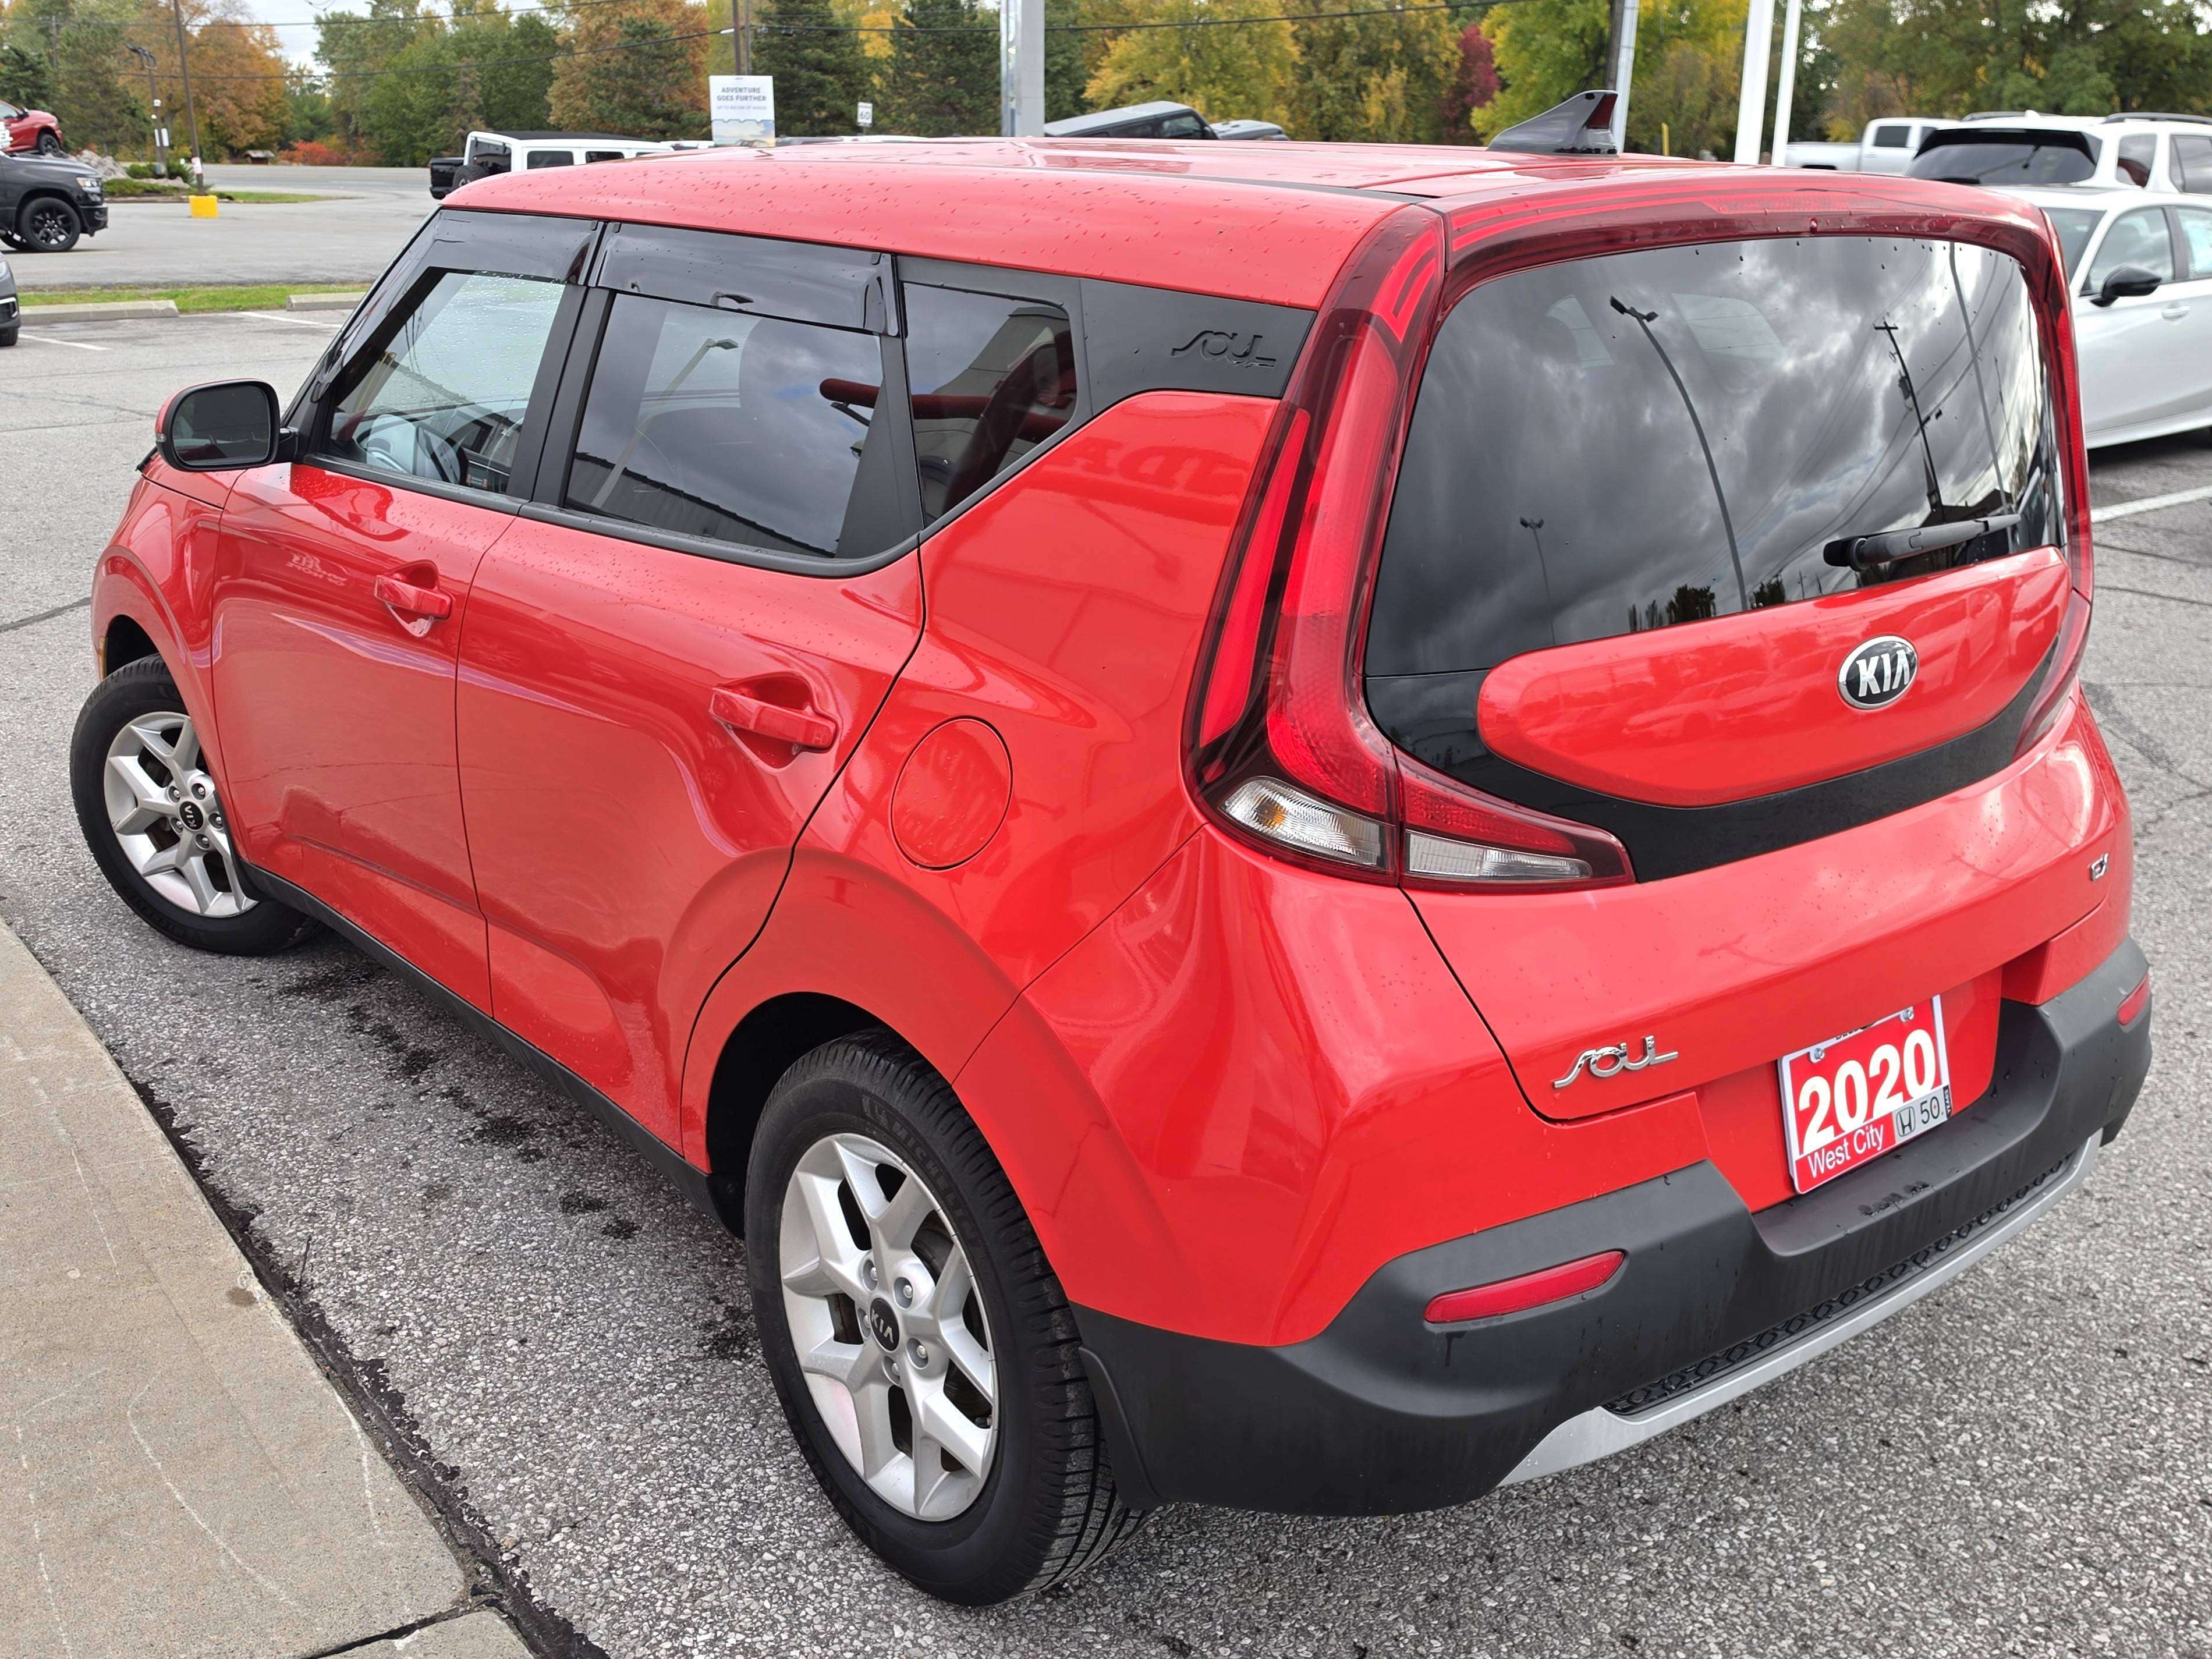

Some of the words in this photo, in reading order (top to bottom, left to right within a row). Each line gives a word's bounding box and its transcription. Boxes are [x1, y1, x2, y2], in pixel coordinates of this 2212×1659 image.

[1856, 649, 1910, 697] KIA
[1798, 1029, 1936, 1155] 2020
[1920, 1096, 1940, 1125] 50
[1807, 1140, 1851, 1178] West
[1853, 1123, 1884, 1153] City
[871, 1308, 894, 1343] KIA
